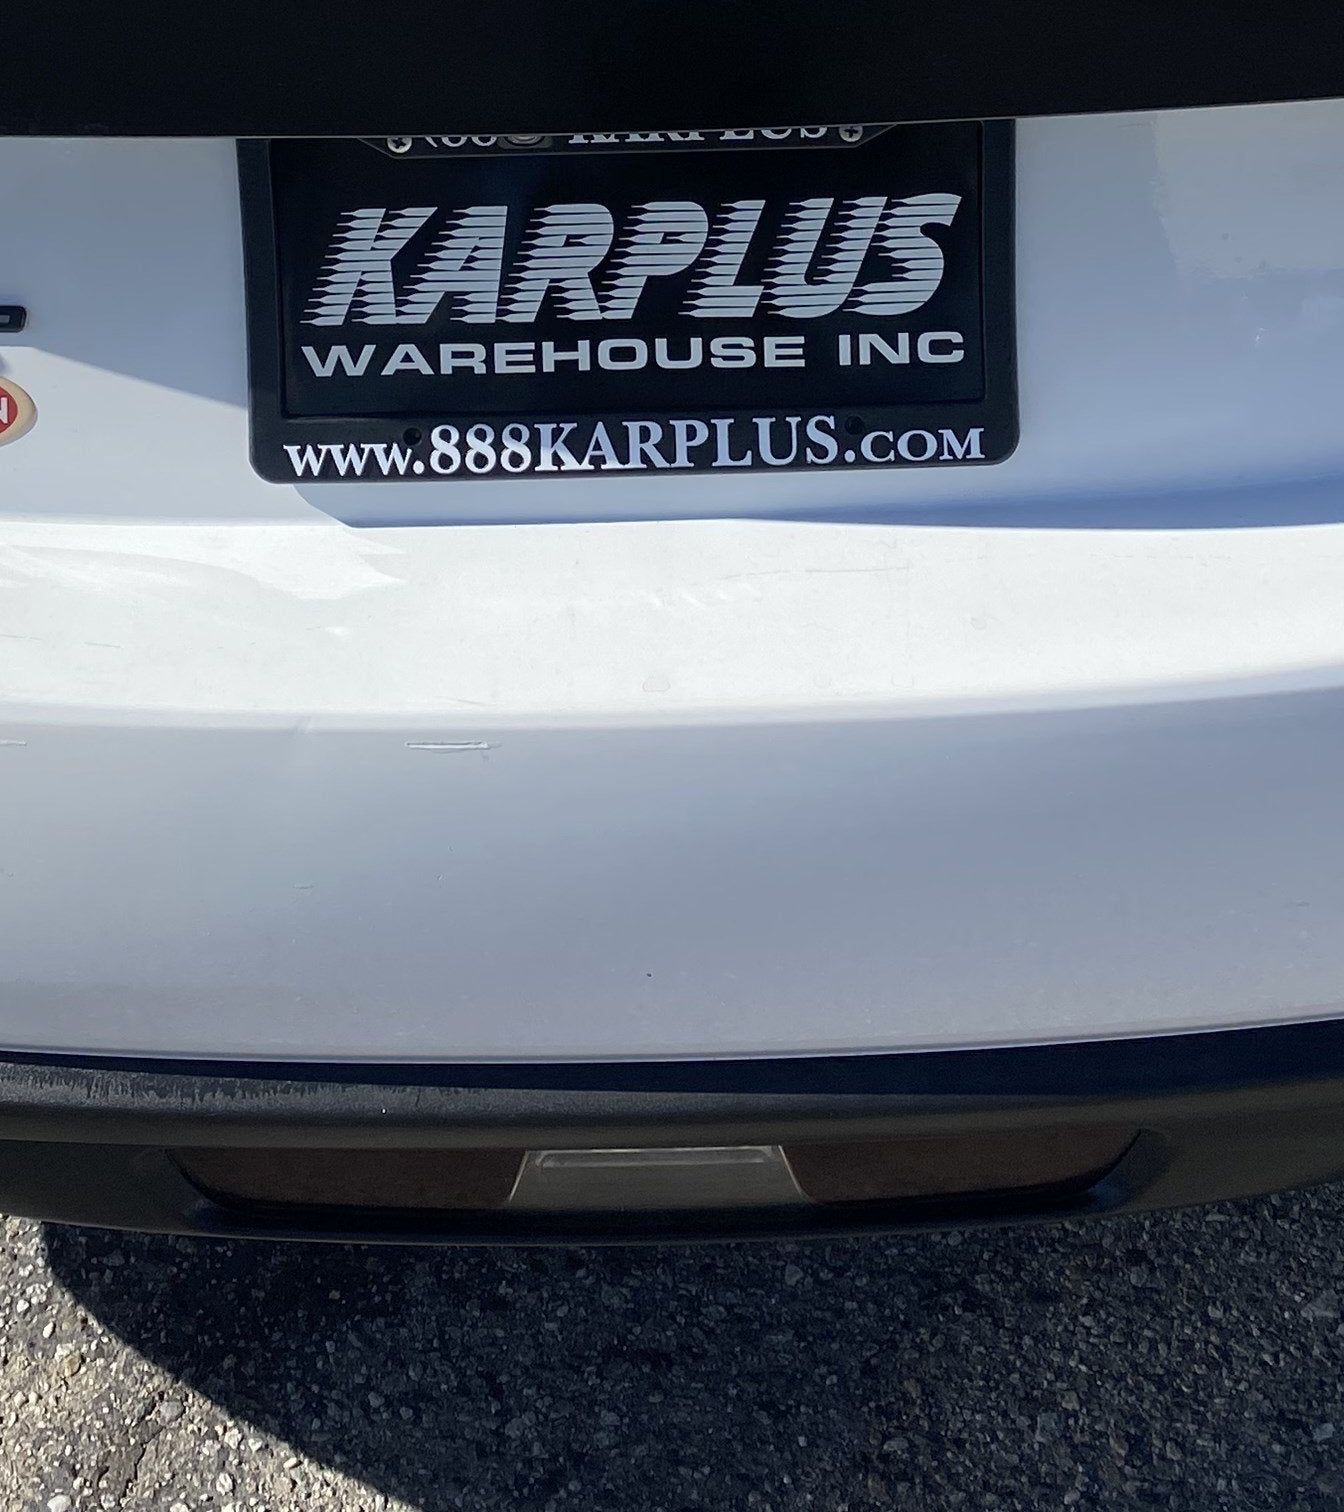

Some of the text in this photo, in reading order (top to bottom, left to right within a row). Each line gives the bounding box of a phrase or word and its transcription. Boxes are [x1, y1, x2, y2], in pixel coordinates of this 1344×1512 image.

[299, 192, 962, 326] KARPLUS
[300, 331, 965, 378] WAREHOUSE INC
